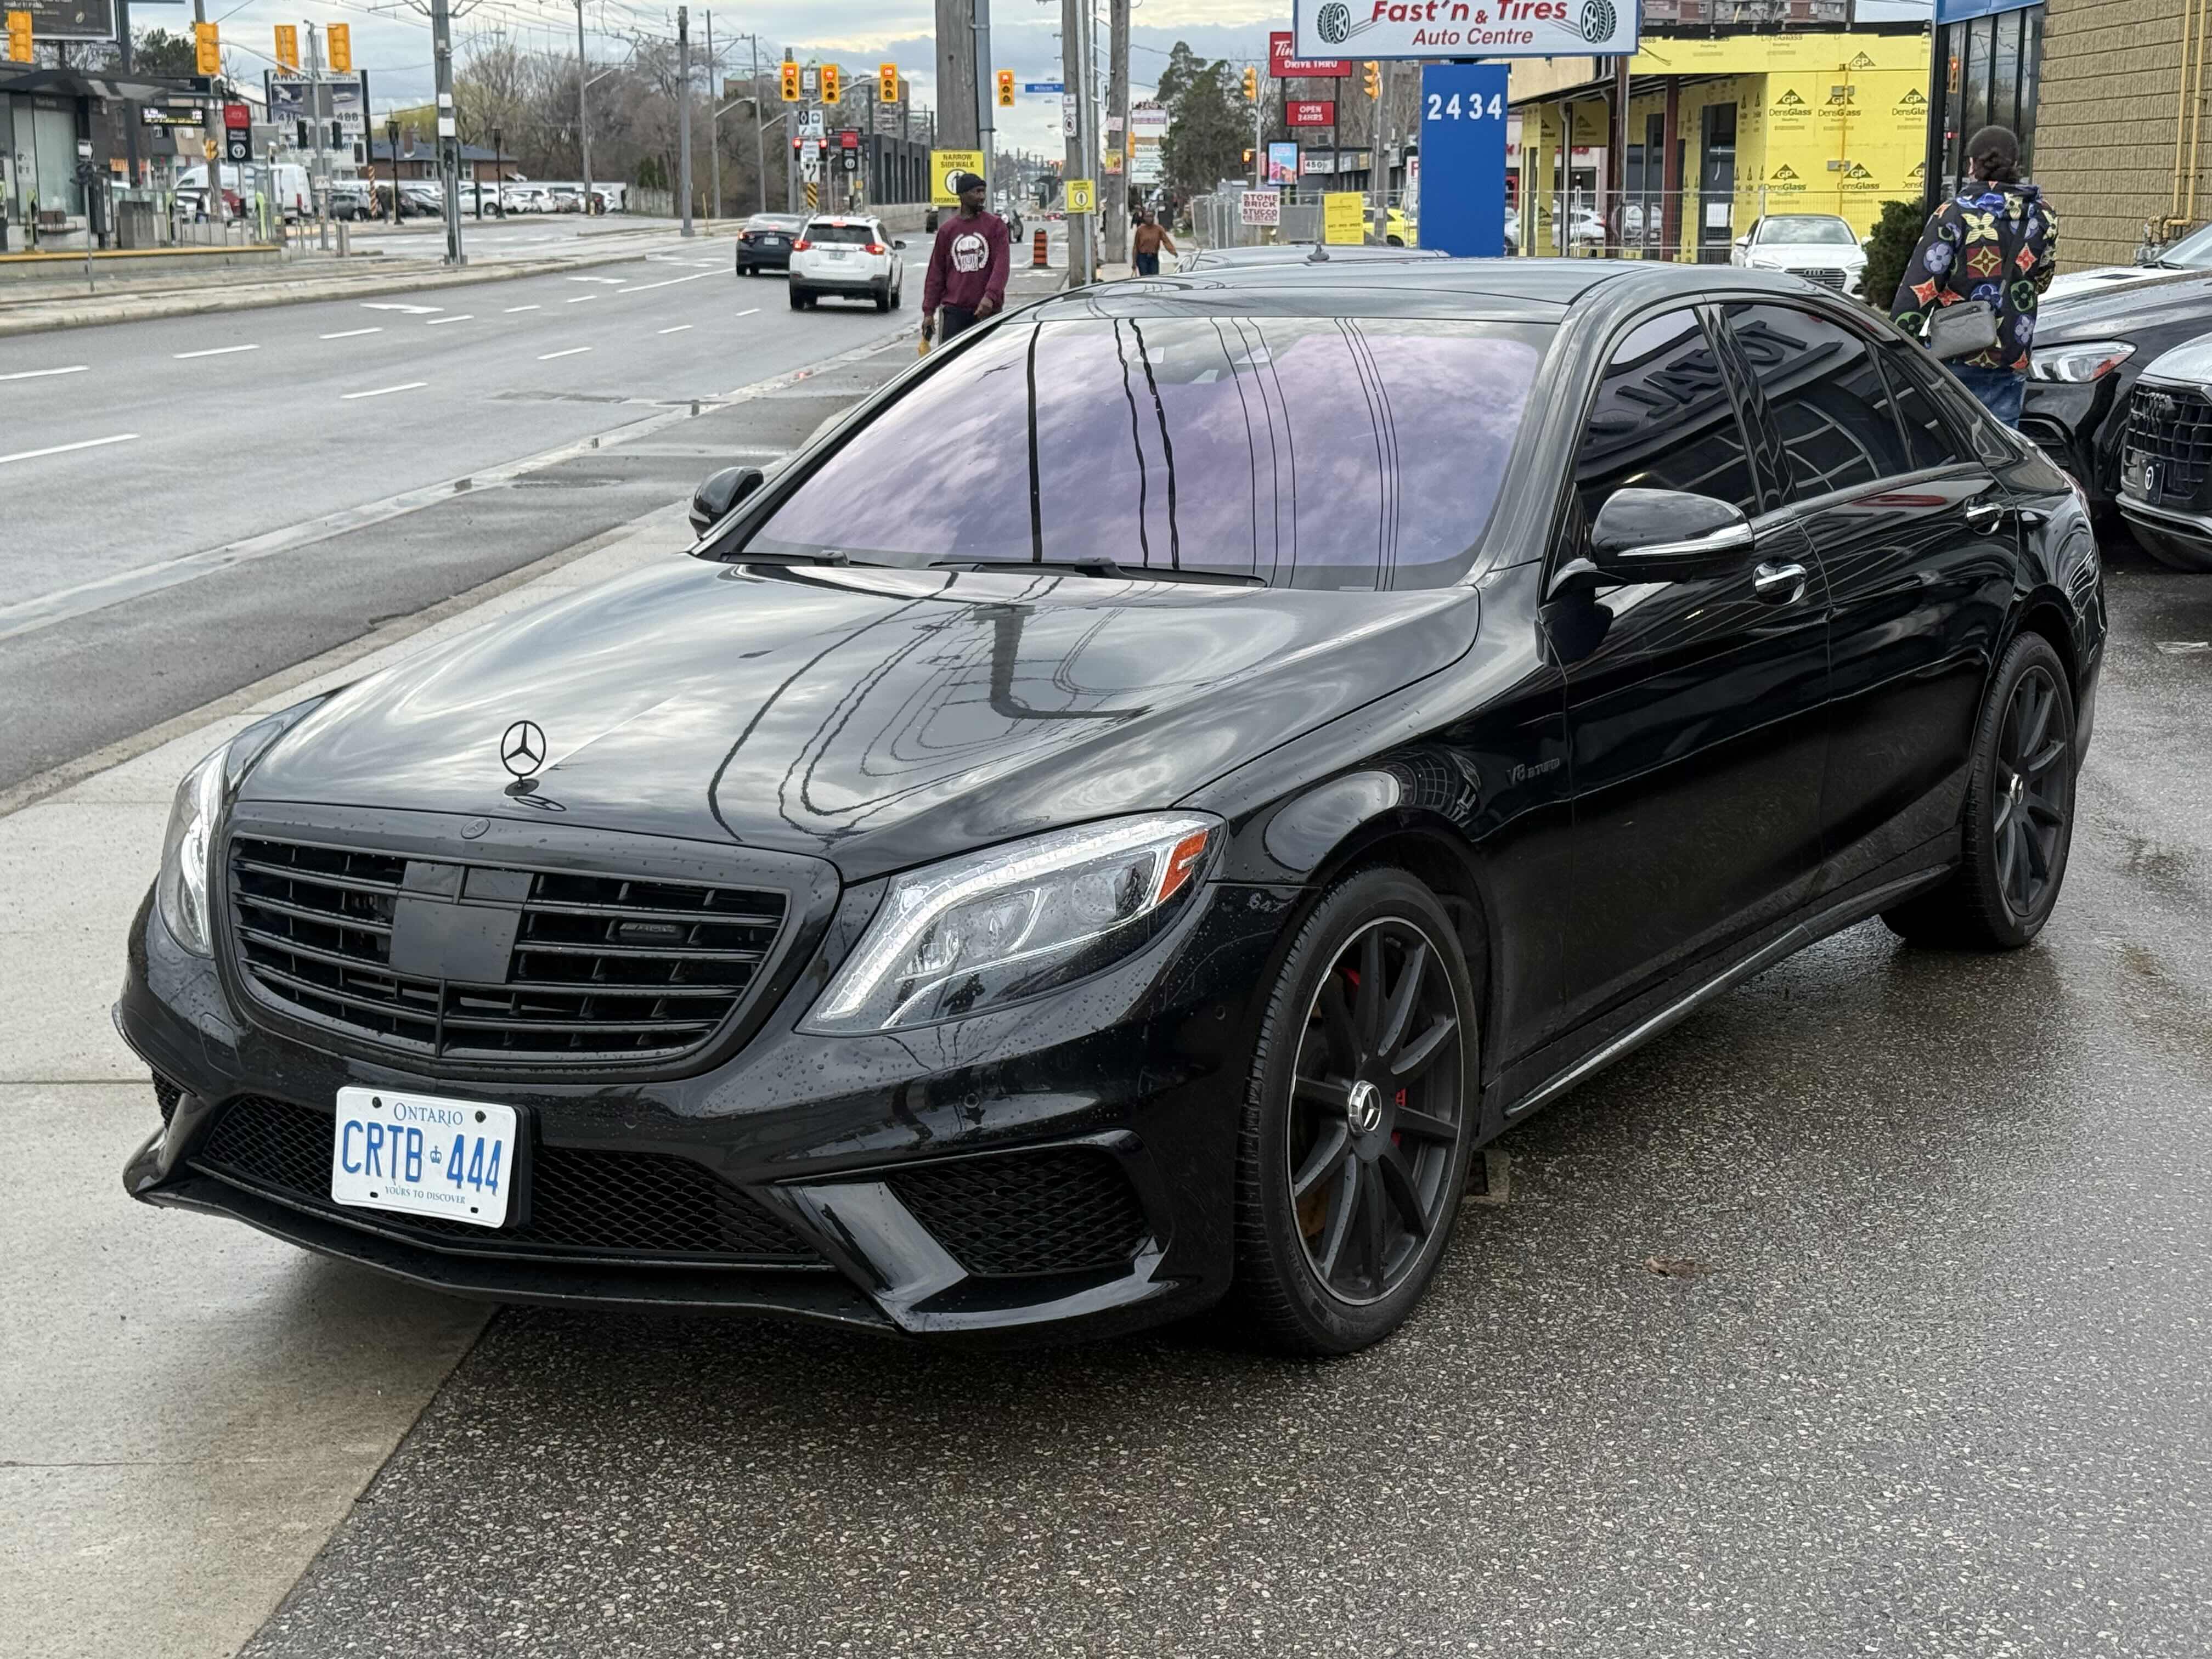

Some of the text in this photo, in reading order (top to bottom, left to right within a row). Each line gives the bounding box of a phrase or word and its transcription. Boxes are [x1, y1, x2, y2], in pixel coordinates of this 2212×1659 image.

[1475, 10, 1488, 24] &
[1496, 0, 1568, 20] Tires
[1413, 27, 1534, 46] Auto Centre
[1284, 60, 1338, 69] DRIVE THRU
[1853, 58, 1869, 67] GP
[1782, 94, 1798, 104] GP
[1905, 94, 1921, 104] GP
[1818, 109, 1861, 117] DensGass
[1892, 108, 1925, 116] DensGla
[1777, 170, 1793, 178] GP
[1850, 169, 1866, 178] GP
[1765, 183, 1807, 191] DensGlass
[394, 1103, 464, 1127] ONTARIO
[342, 1120, 502, 1197] CRTB 444
[384, 1185, 466, 1205] YOURS TO DISCOVER
